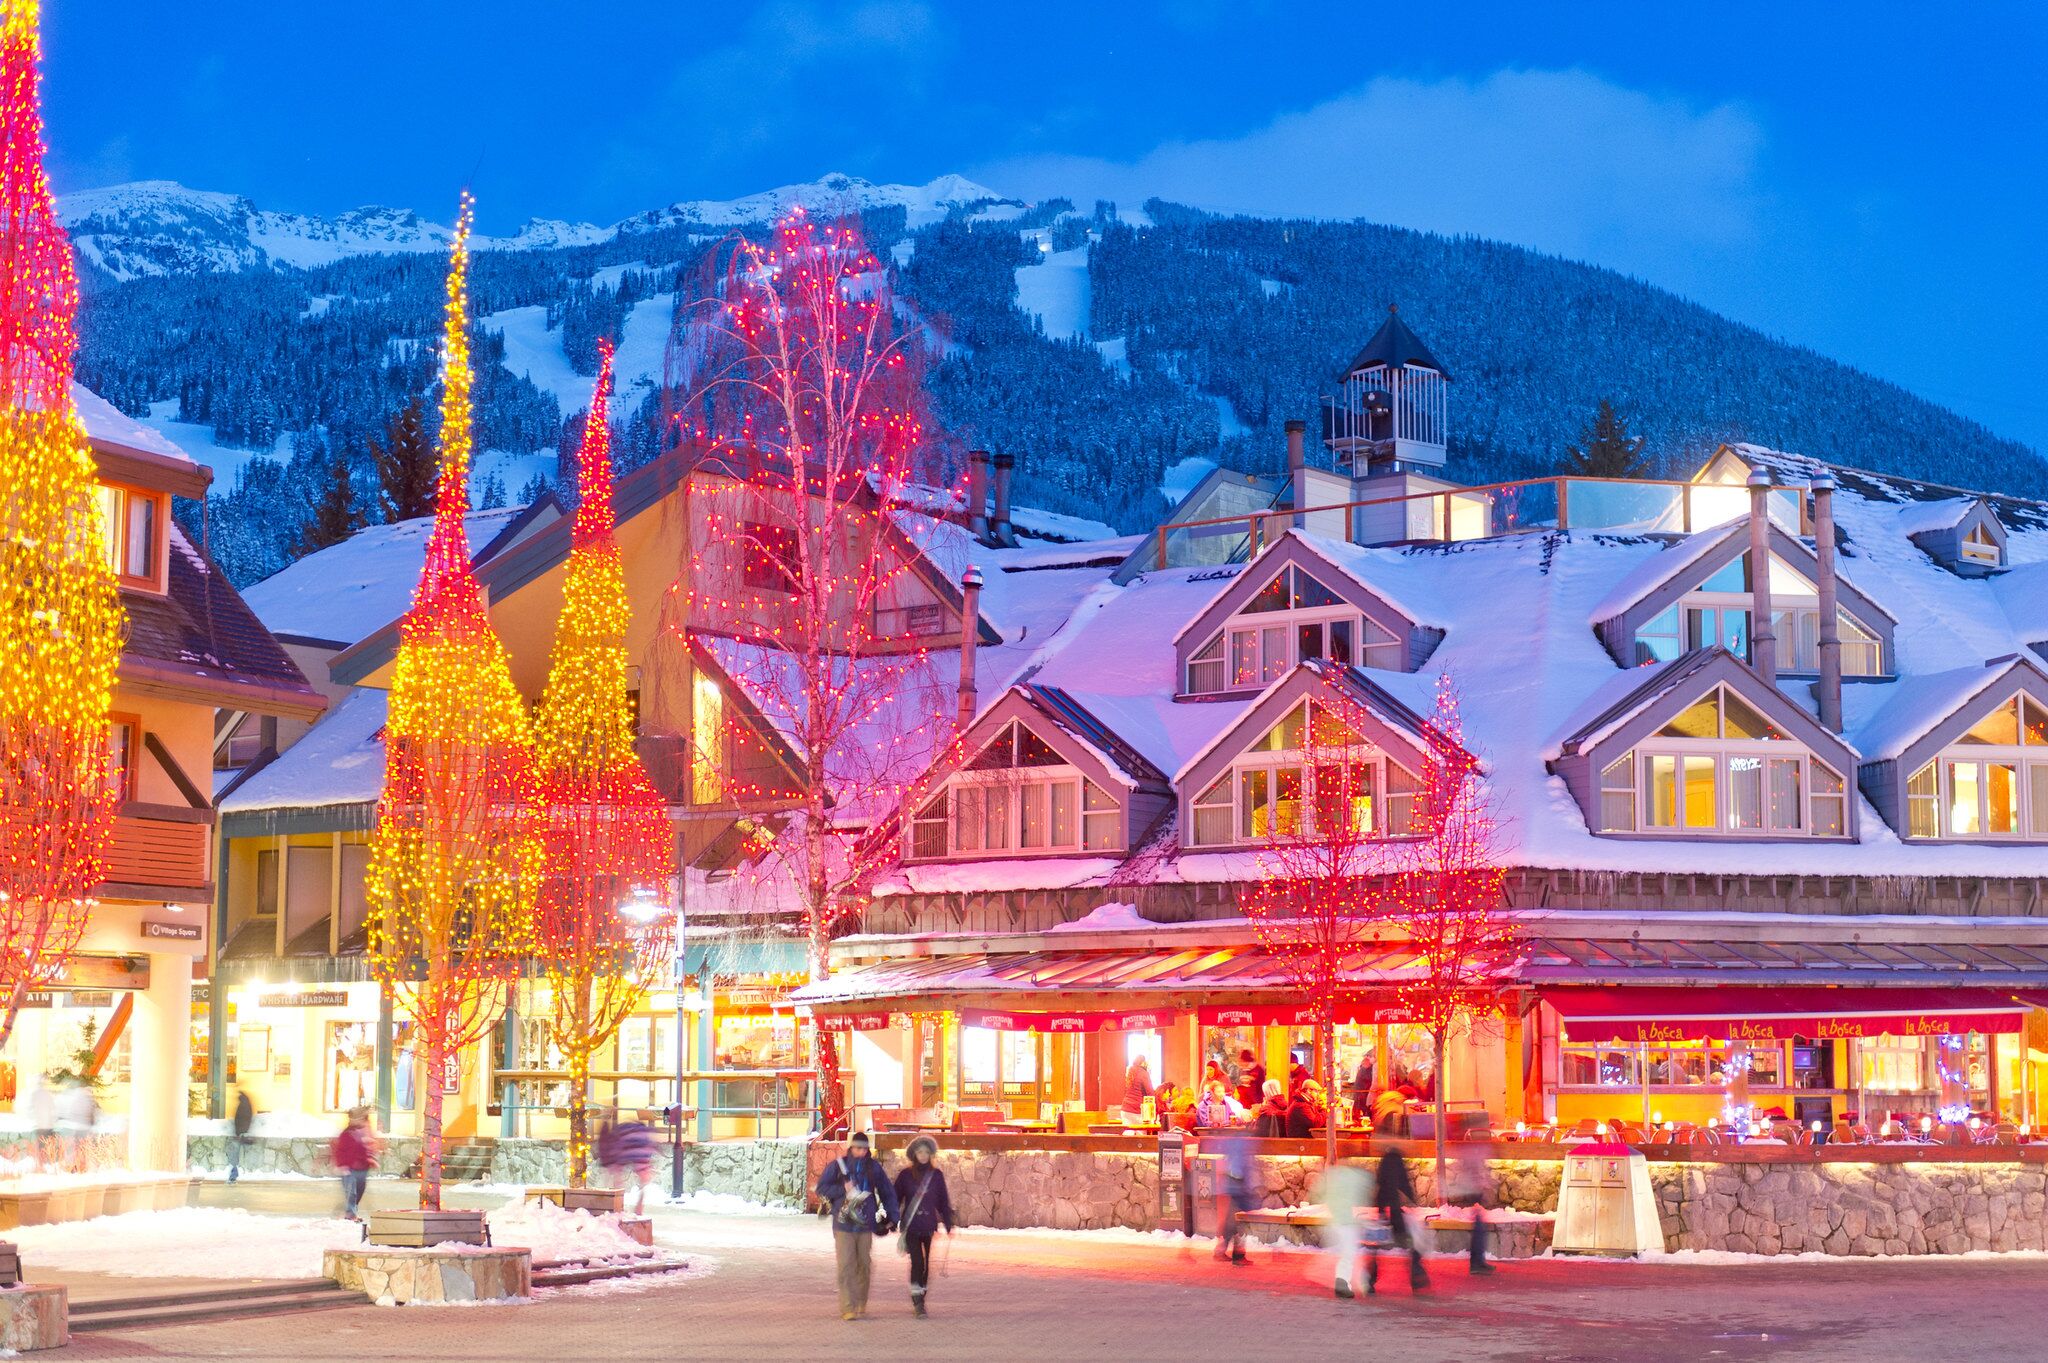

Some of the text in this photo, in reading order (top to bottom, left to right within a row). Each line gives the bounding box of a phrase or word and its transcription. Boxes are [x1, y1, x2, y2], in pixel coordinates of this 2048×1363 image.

[161, 926, 197, 937] Village Square
[300, 994, 344, 1005] HARDWARE
[1122, 1014, 1157, 1029] AMSTERDAM
[1217, 1010, 1253, 1023] AMSTERDAM
[1374, 1008, 1412, 1021] AMSTERDAM
[1050, 1017, 1084, 1030] AMSTERDAM
[1729, 1021, 1775, 1040] la bocca
[1818, 1019, 1862, 1038] la bocca
[1906, 1017, 1949, 1035] la bocca
[1638, 1022, 1684, 1041] la bocca
